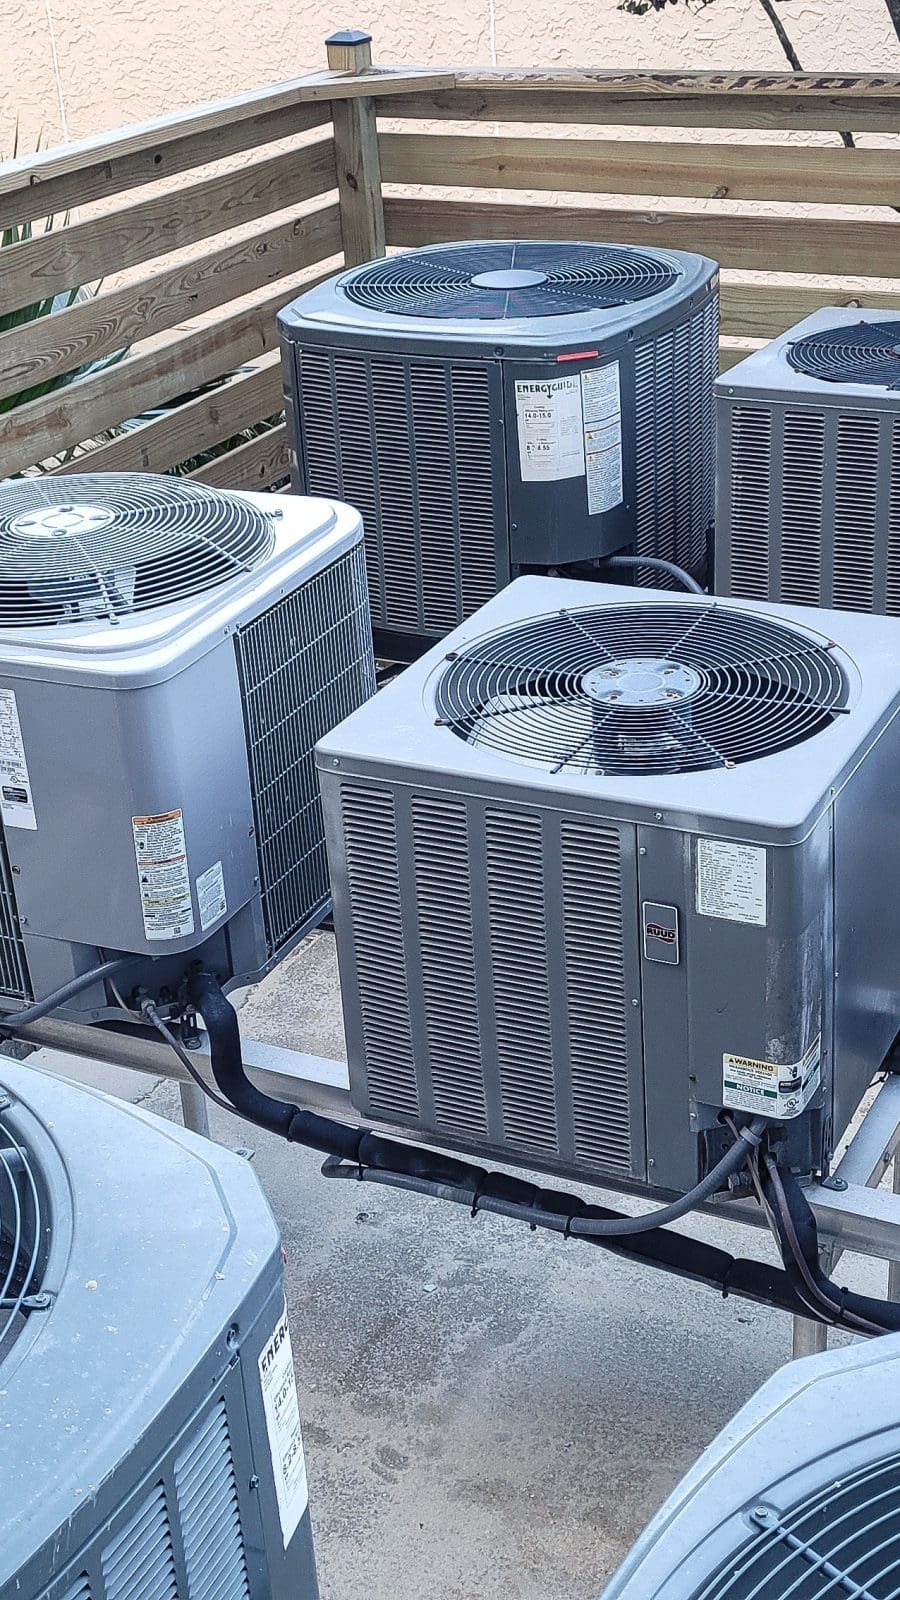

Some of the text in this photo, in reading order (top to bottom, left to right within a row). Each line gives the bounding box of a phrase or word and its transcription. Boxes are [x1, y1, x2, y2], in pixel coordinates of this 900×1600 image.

[646, 926, 676, 939] RUUD
[734, 1057, 774, 1072] WARNING
[736, 1083, 766, 1096] NOTICE
